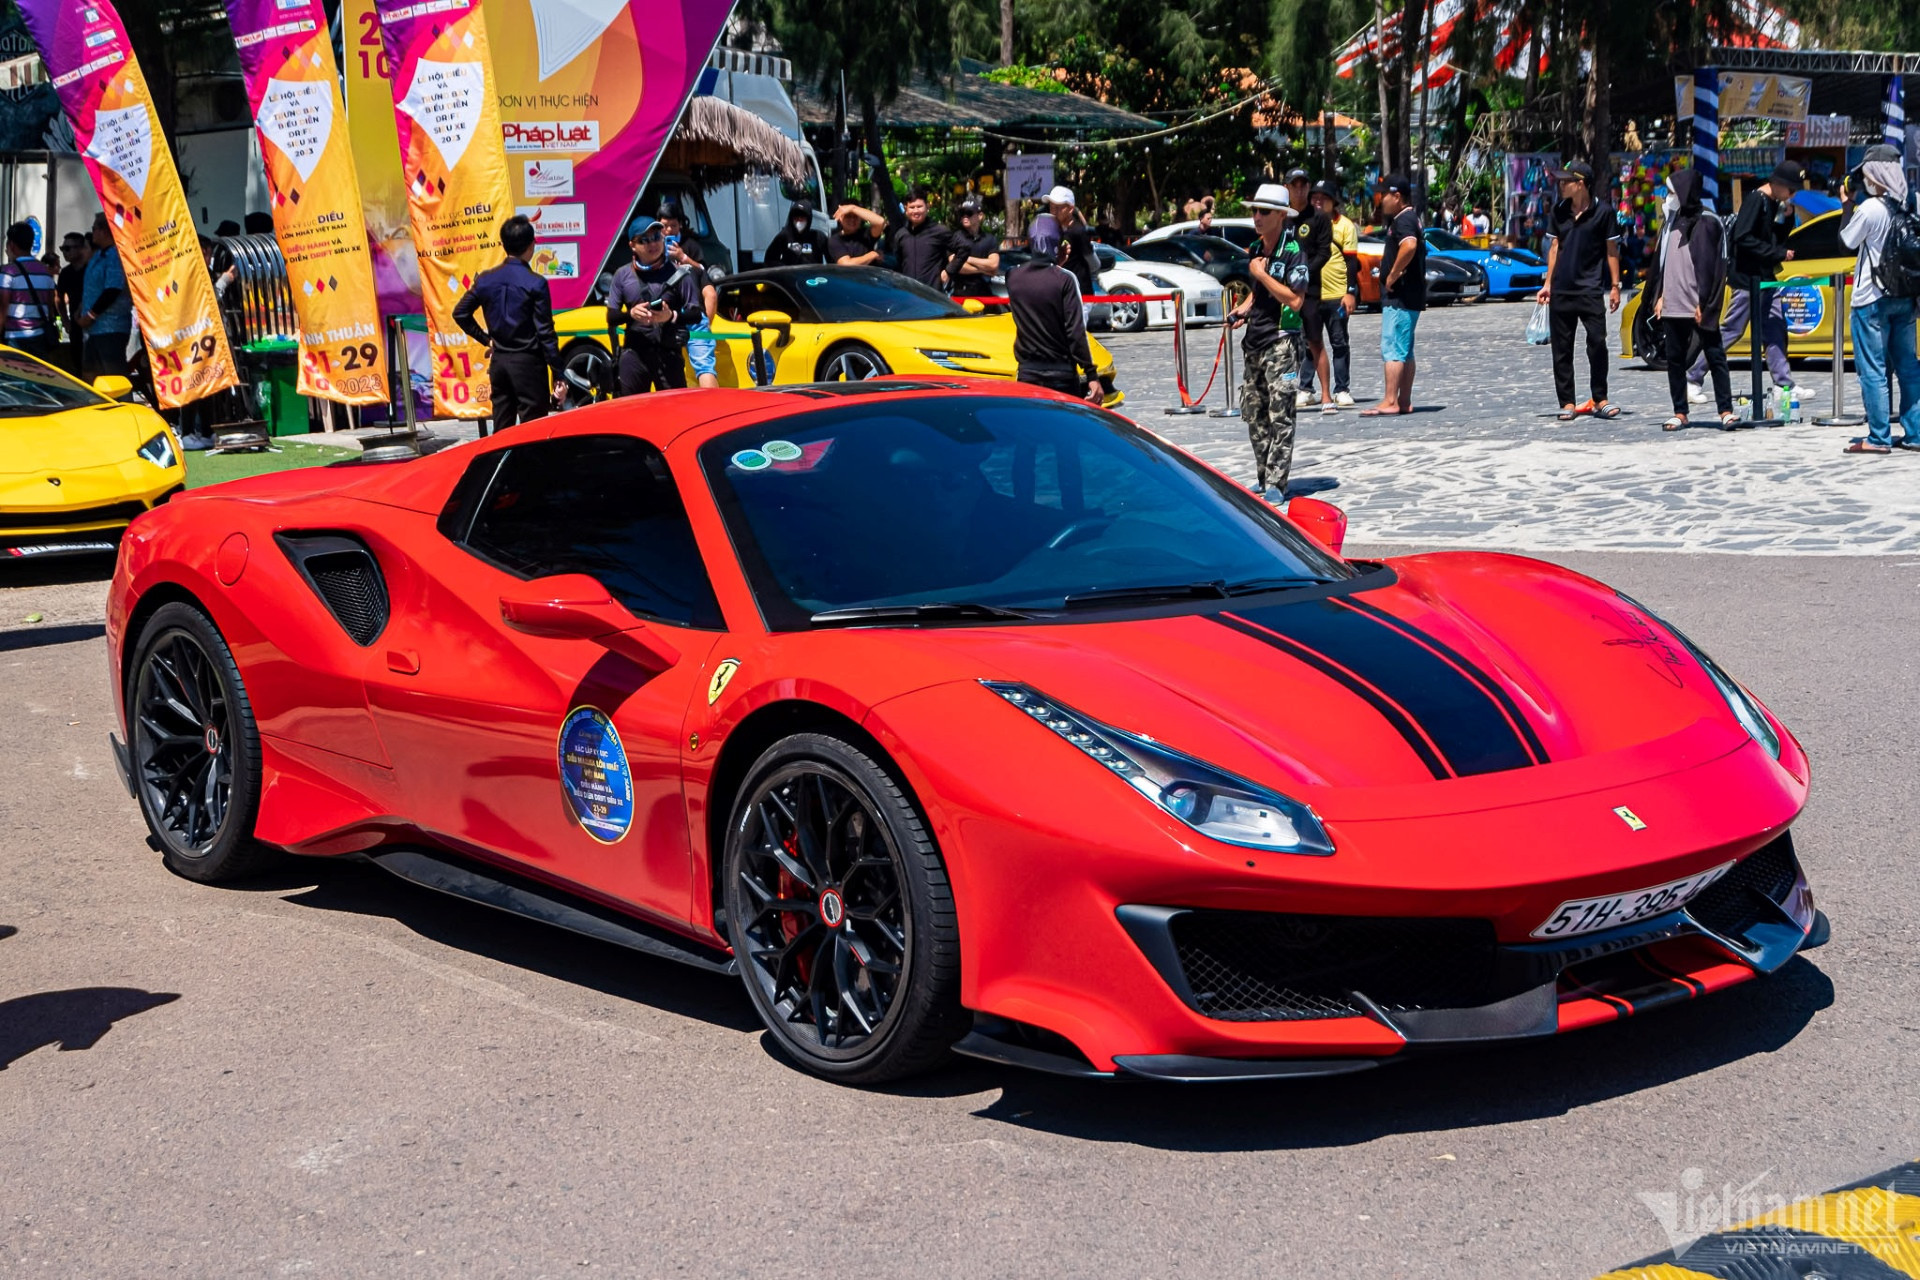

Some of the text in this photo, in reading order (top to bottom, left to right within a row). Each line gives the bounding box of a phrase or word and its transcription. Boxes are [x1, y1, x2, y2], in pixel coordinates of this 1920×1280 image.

[525, 95, 537, 110] VỊ
[539, 93, 570, 110] THỰC
[573, 91, 599, 109] HIỆN
[325, 321, 376, 343] THUẬN
[190, 335, 217, 365] 29
[303, 342, 378, 374] 21 29
[438, 351, 472, 379] 21
[336, 373, 384, 396] 2023
[438, 381, 470, 404] 10
